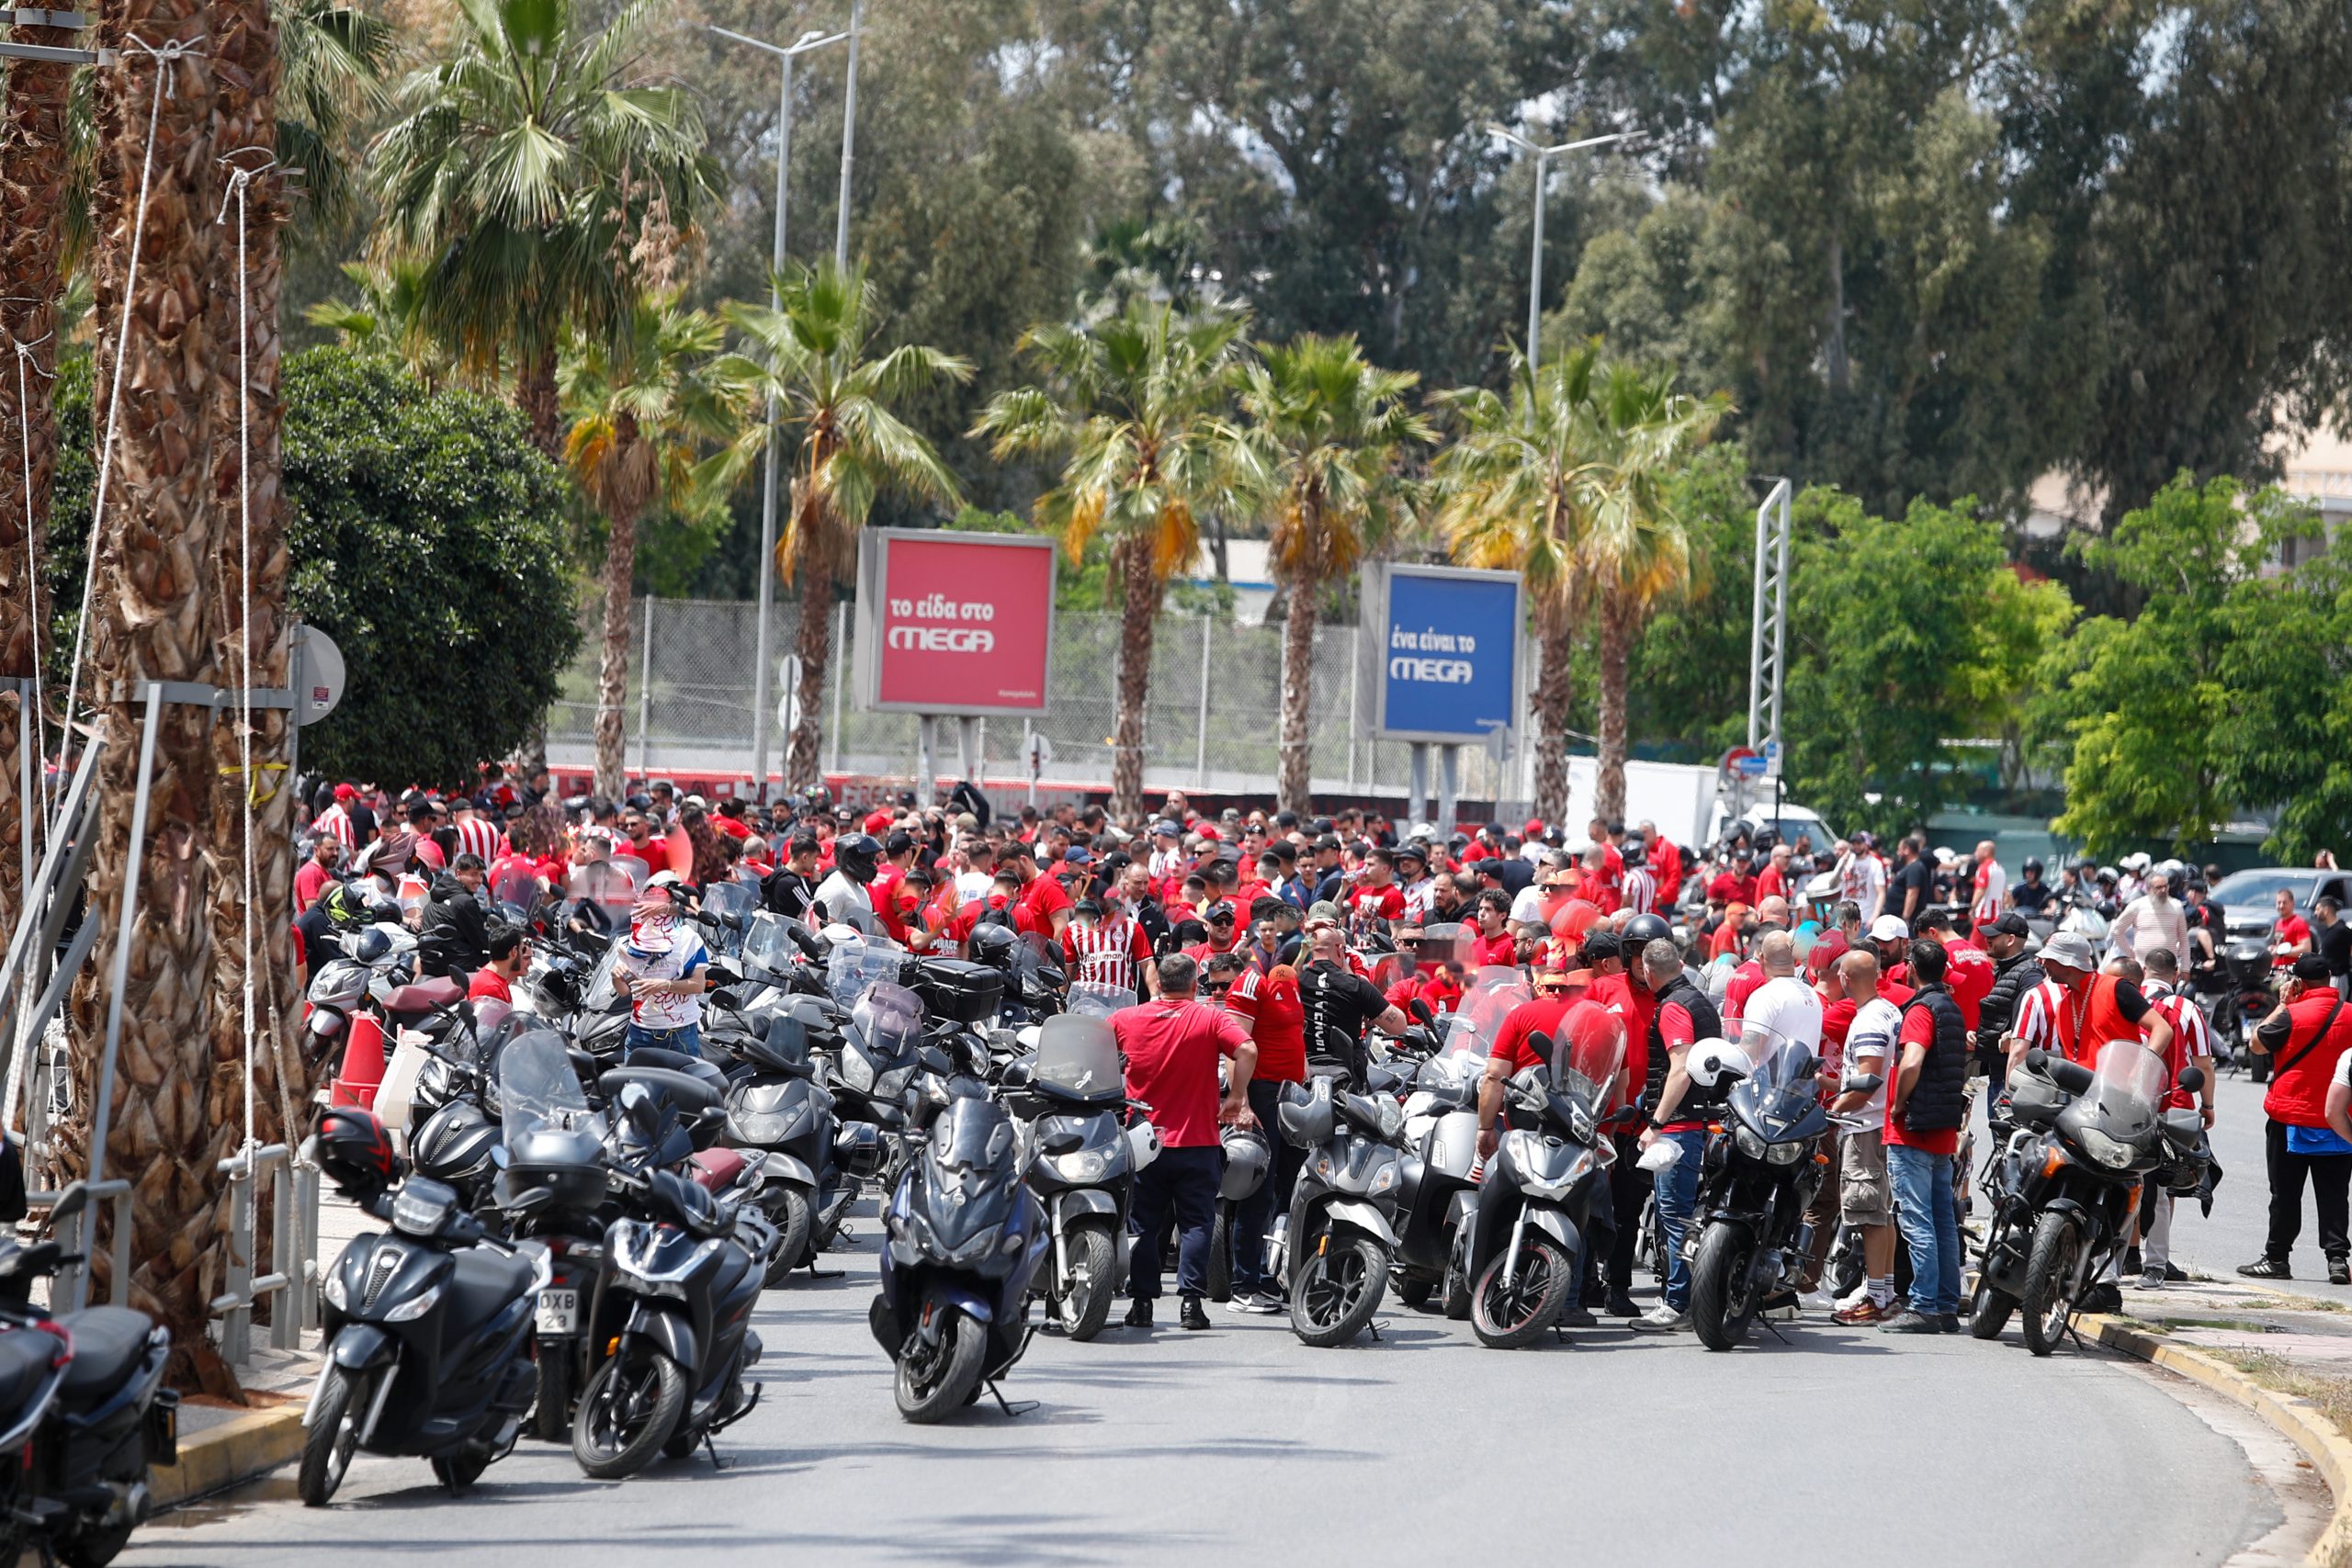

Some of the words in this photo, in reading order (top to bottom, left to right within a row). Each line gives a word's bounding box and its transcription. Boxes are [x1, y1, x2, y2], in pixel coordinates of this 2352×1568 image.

[890, 598, 913, 617] το
[916, 592, 957, 620] είδα
[960, 602, 994, 622] στο
[888, 626, 995, 653] MEGA
[1391, 624, 1418, 650] ένα
[1419, 626, 1456, 652] είναι
[1456, 635, 1476, 654] το
[1389, 656, 1474, 684] MEGA
